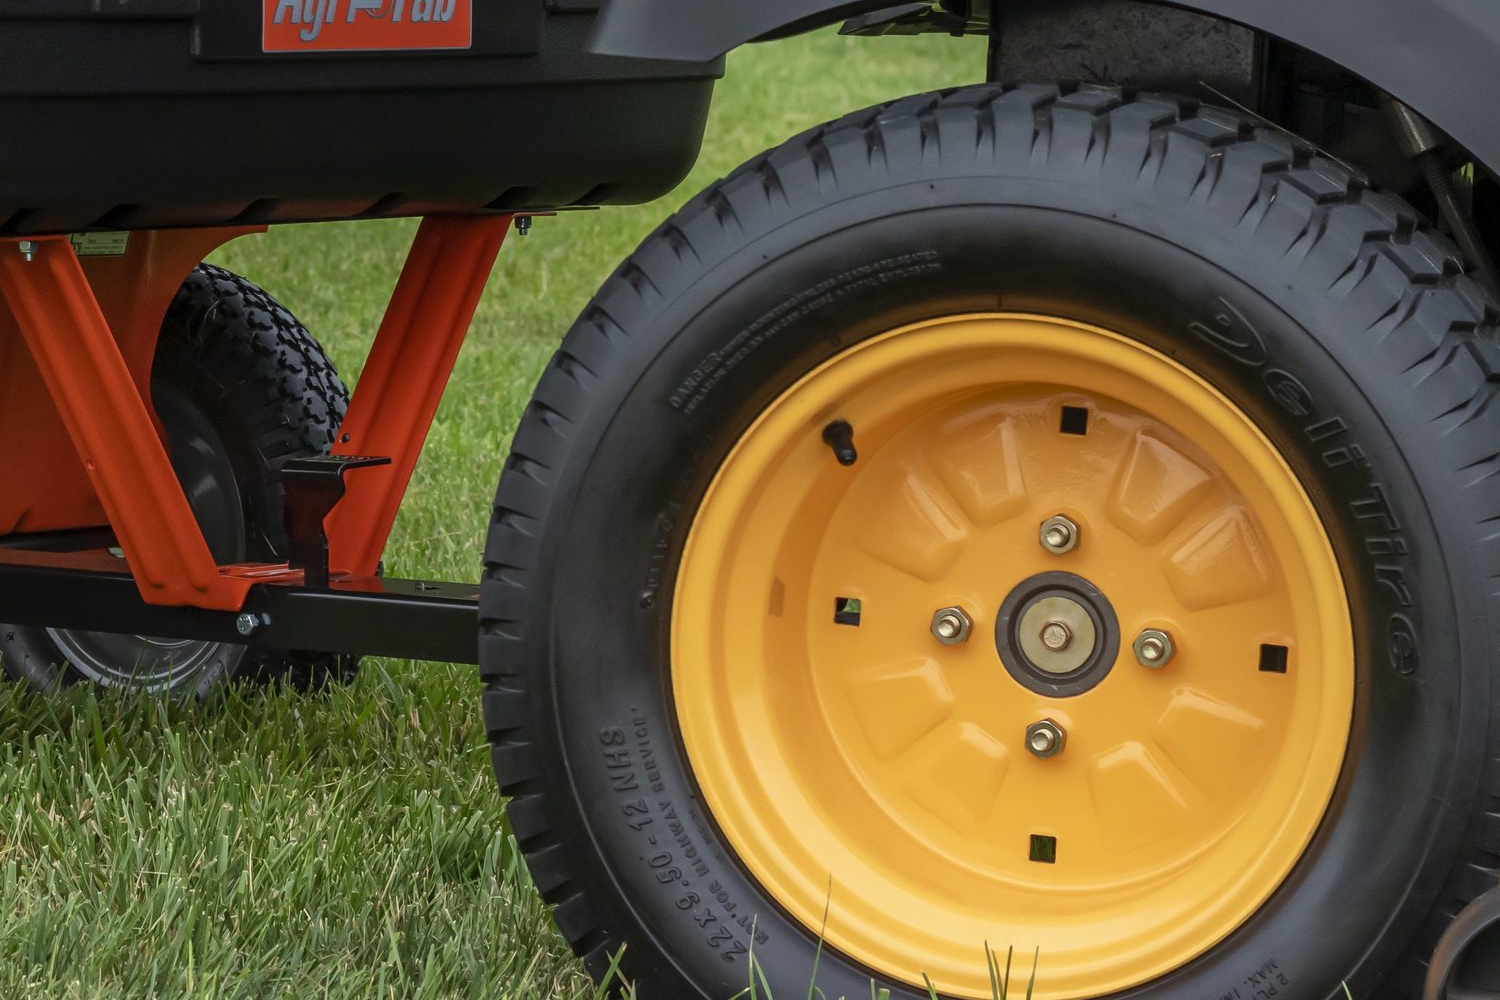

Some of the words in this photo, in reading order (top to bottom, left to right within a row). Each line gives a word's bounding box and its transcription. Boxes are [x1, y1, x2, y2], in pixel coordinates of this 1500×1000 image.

[597, 726, 640, 797] NHS
[631, 716, 665, 795] SERVICE
[619, 797, 655, 835] 12
[657, 798, 710, 879] HIGHWAY
[645, 849, 702, 916] 9.50
[705, 879, 738, 914] FOR
[706, 927, 749, 965] 22
[735, 912, 770, 947] NOT
[1252, 983, 1278, 1000] PL
